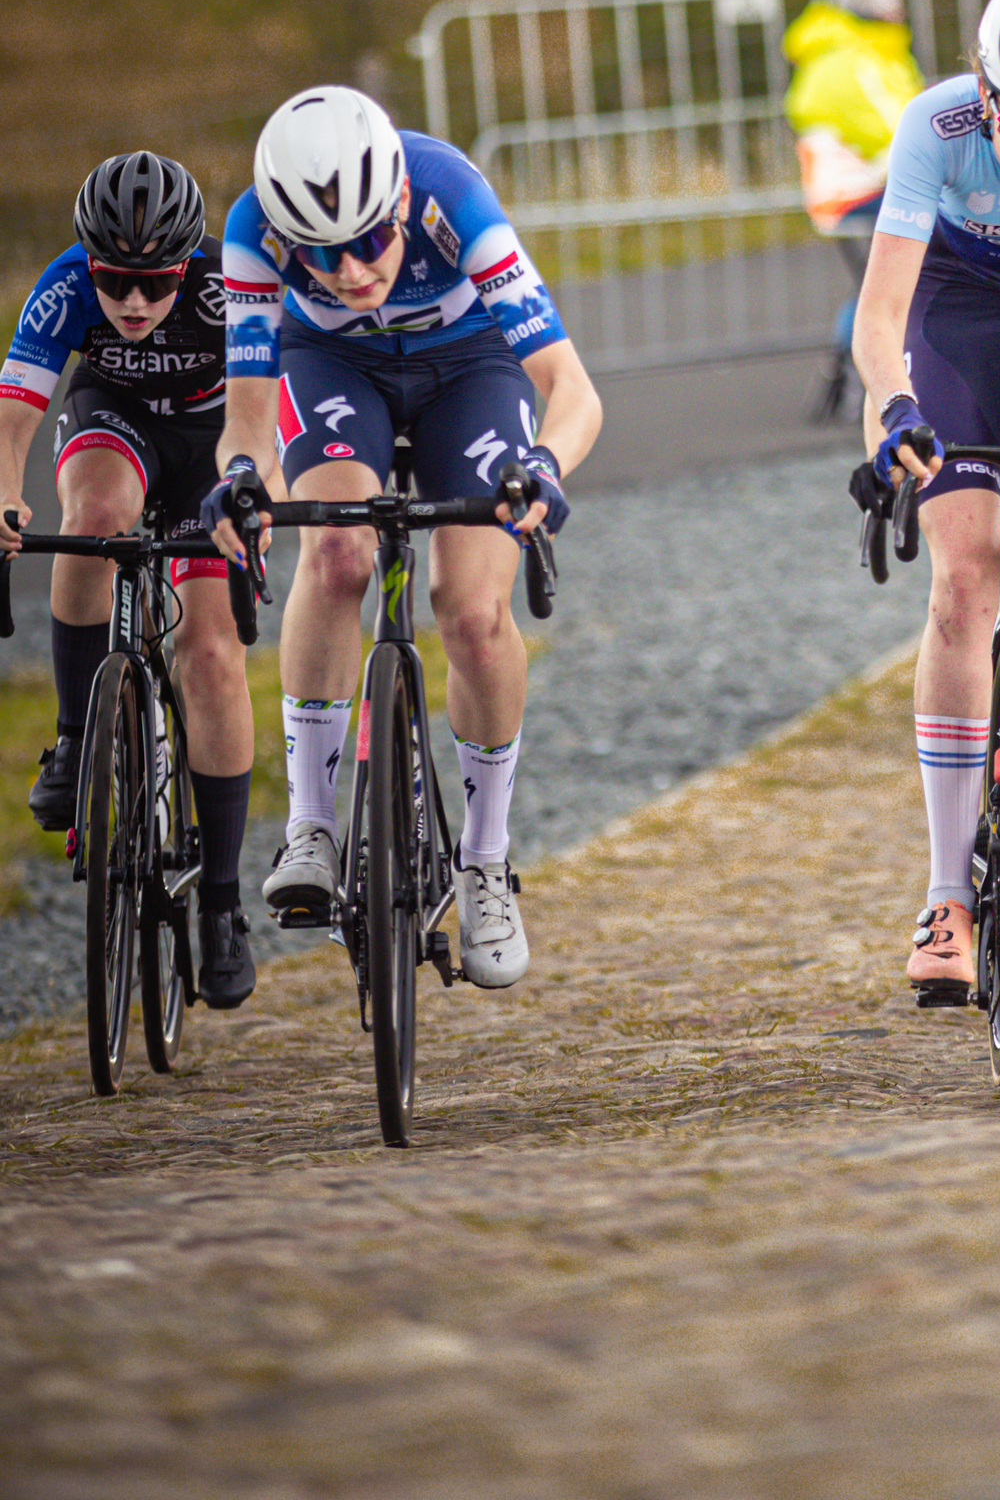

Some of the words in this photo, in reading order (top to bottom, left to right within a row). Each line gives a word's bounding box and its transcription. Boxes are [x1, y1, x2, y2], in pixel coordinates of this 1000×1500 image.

[226, 292, 280, 304] OUDAL
[476, 264, 526, 298] OUDAL
[120, 579, 133, 645] GIANT
